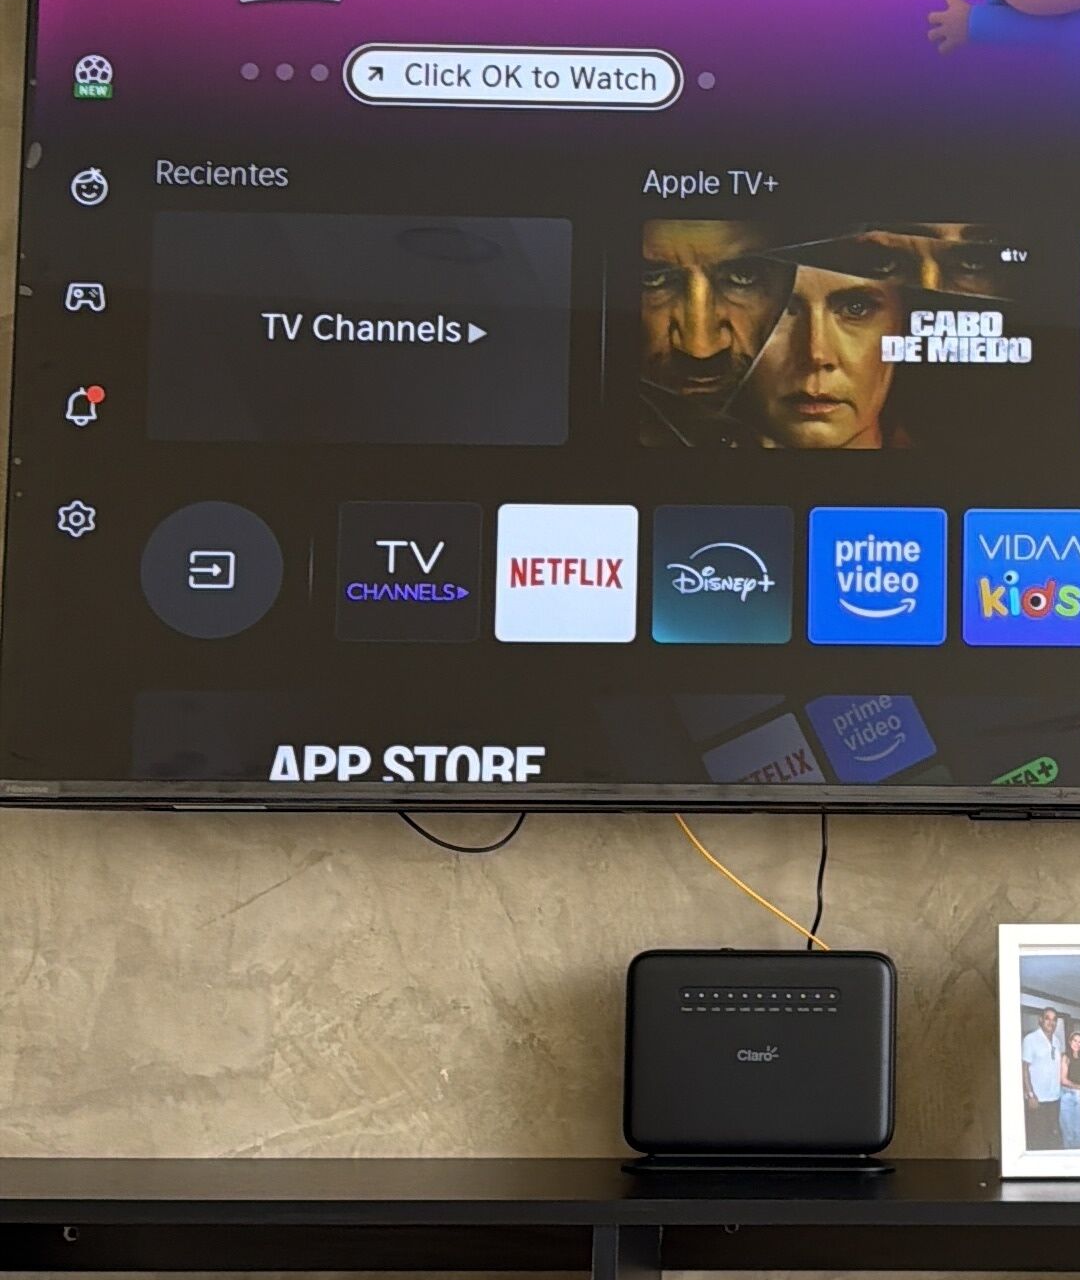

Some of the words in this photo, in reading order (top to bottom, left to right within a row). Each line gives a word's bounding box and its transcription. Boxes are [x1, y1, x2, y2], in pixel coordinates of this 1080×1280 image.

[79, 83, 109, 97] NEW
[403, 62, 470, 89] Click
[480, 65, 522, 91] OK
[531, 68, 559, 91] to
[569, 66, 657, 92] Watch
[155, 159, 289, 188] Recientes
[643, 169, 720, 199] Apple
[727, 170, 779, 196] TV+
[261, 312, 303, 341] TV
[312, 313, 462, 345] Channels
[910, 310, 1004, 337] CABO
[881, 335, 923, 363] DE
[927, 336, 1032, 364] MIEDO
[375, 539, 445, 574] TV
[835, 534, 921, 566] prime
[509, 557, 623, 590] NETFLIX
[837, 565, 920, 594] video
[346, 582, 456, 601] CHANNELS
[832, 694, 893, 734] prime
[843, 713, 902, 752] video
[269, 745, 372, 782] APP
[736, 1049, 773, 1062] Claro
